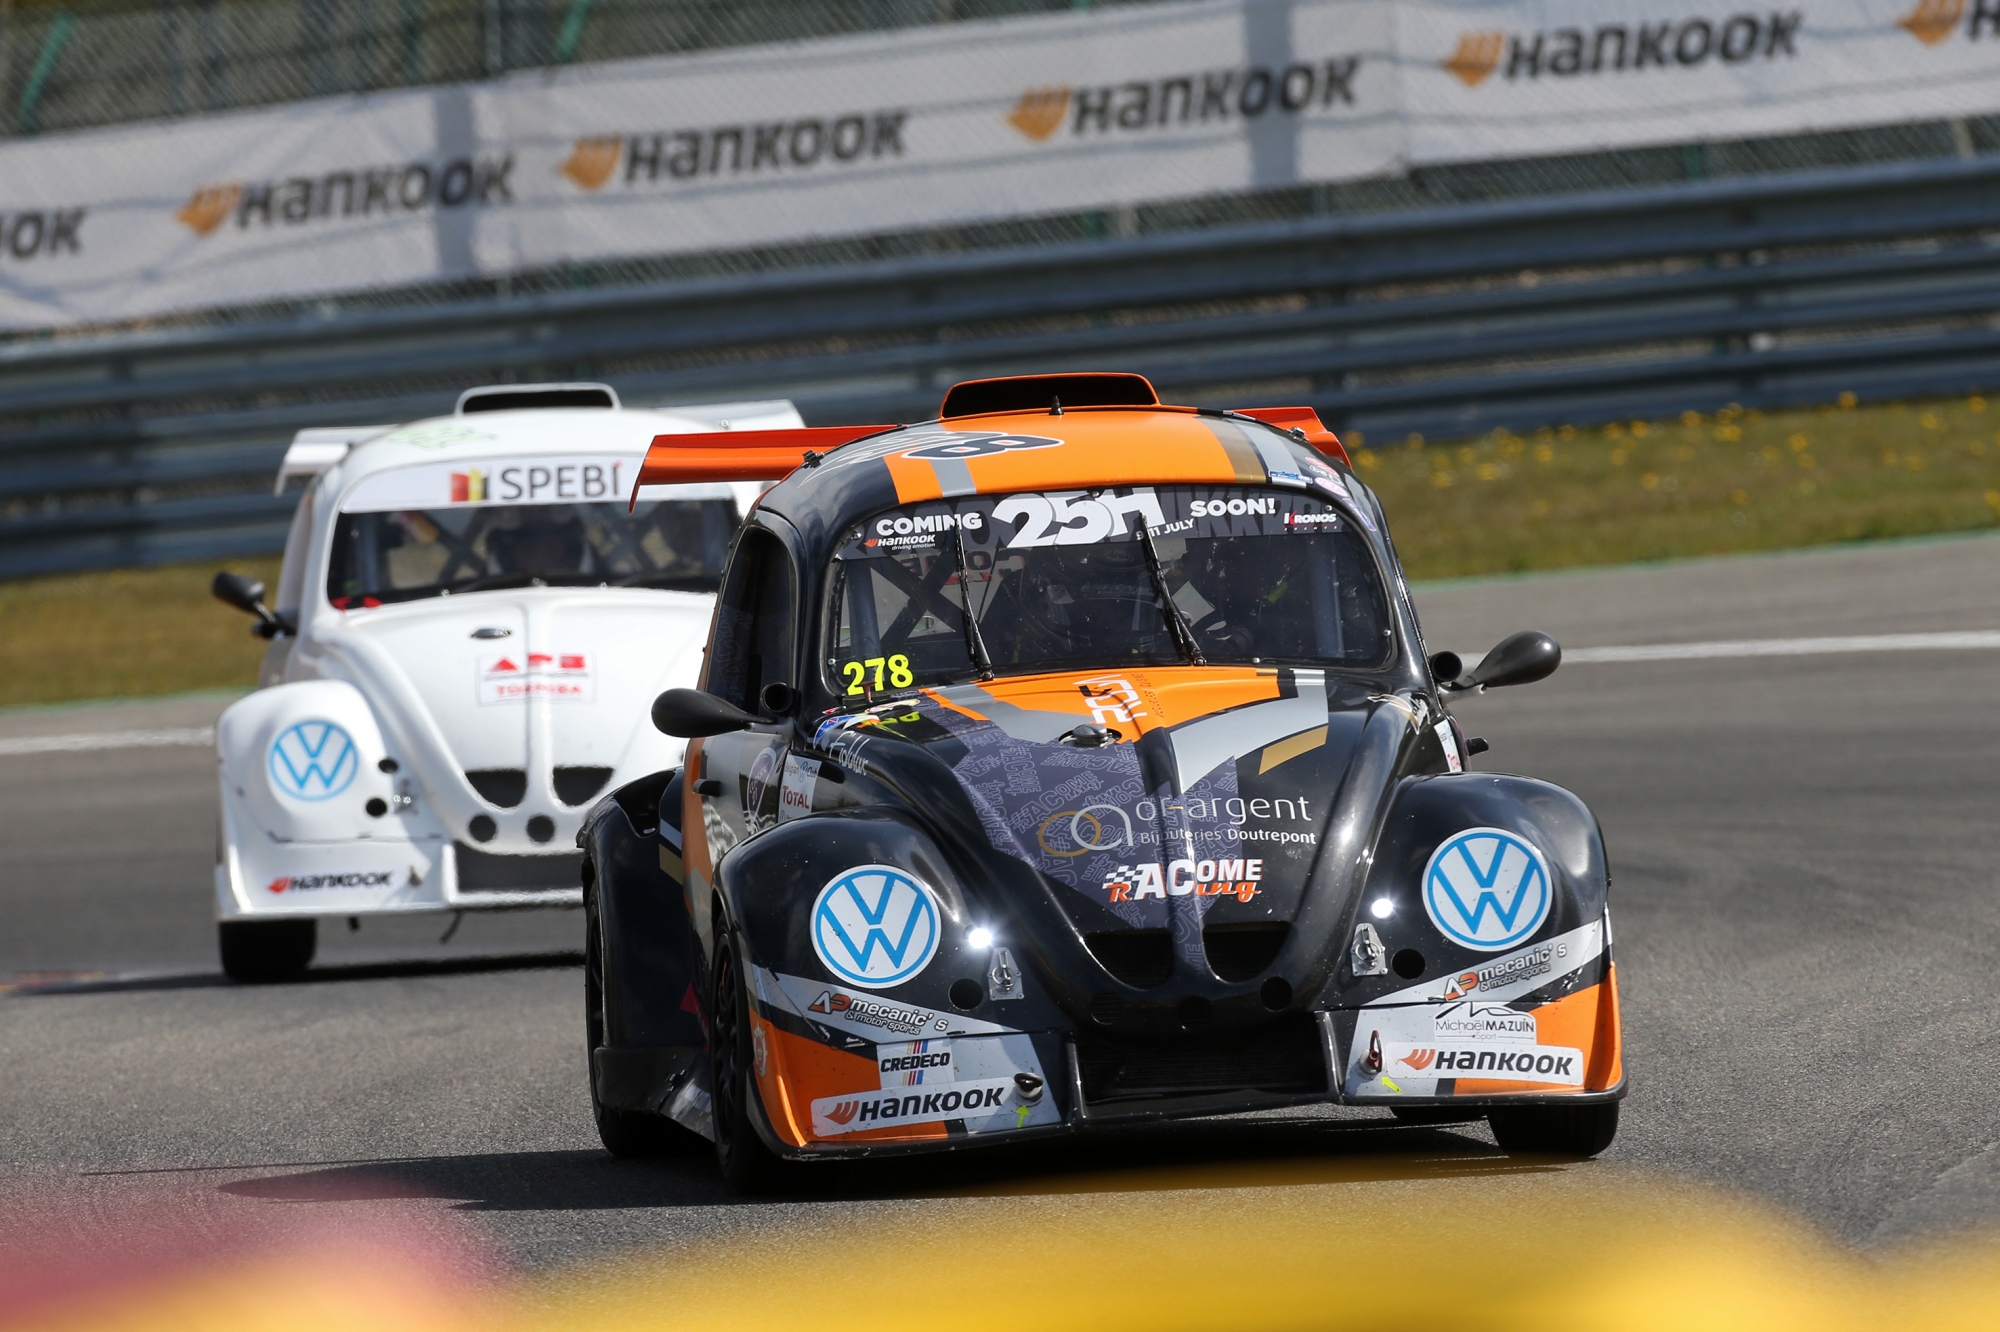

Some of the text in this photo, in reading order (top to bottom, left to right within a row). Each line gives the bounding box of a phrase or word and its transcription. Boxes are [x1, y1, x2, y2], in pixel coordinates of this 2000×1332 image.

[1190, 497, 1277, 518] SOON!
[1284, 509, 1338, 525] KRONOS
[876, 512, 983, 537] COMING
[1163, 518, 1194, 535] JULY
[843, 653, 914, 696] 278
[1140, 828, 1317, 845] Bijouteries Doutrepont
[1490, 973, 1519, 989] motor
[1519, 963, 1551, 980] sports
[855, 1013, 888, 1026] motor
[888, 1020, 921, 1036] sports
[1476, 1032, 1497, 1041] Sport
[881, 1052, 950, 1073] CREDECO
